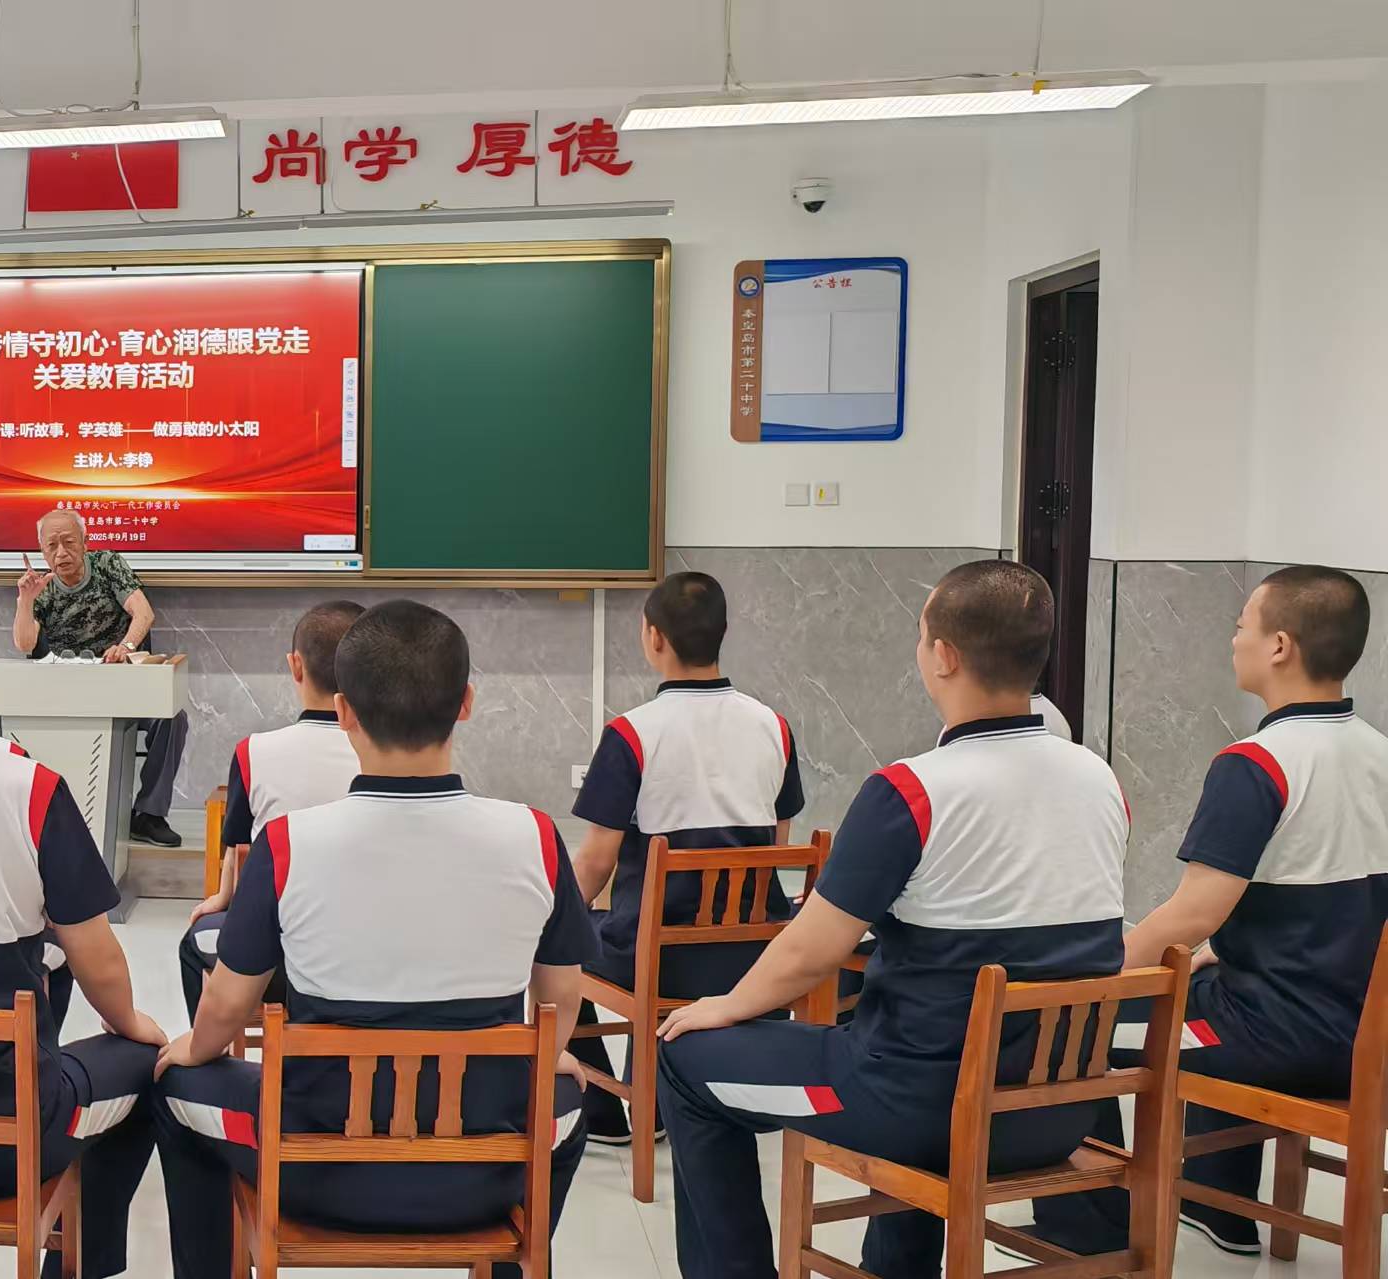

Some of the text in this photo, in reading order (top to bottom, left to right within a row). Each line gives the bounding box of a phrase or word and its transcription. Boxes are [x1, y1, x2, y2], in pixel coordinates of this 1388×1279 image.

[251, 118, 634, 185] 尚学 厚德
[33, 362, 194, 391] 关爱教育活动
[88, 532, 147, 541] 2025年9月19日
